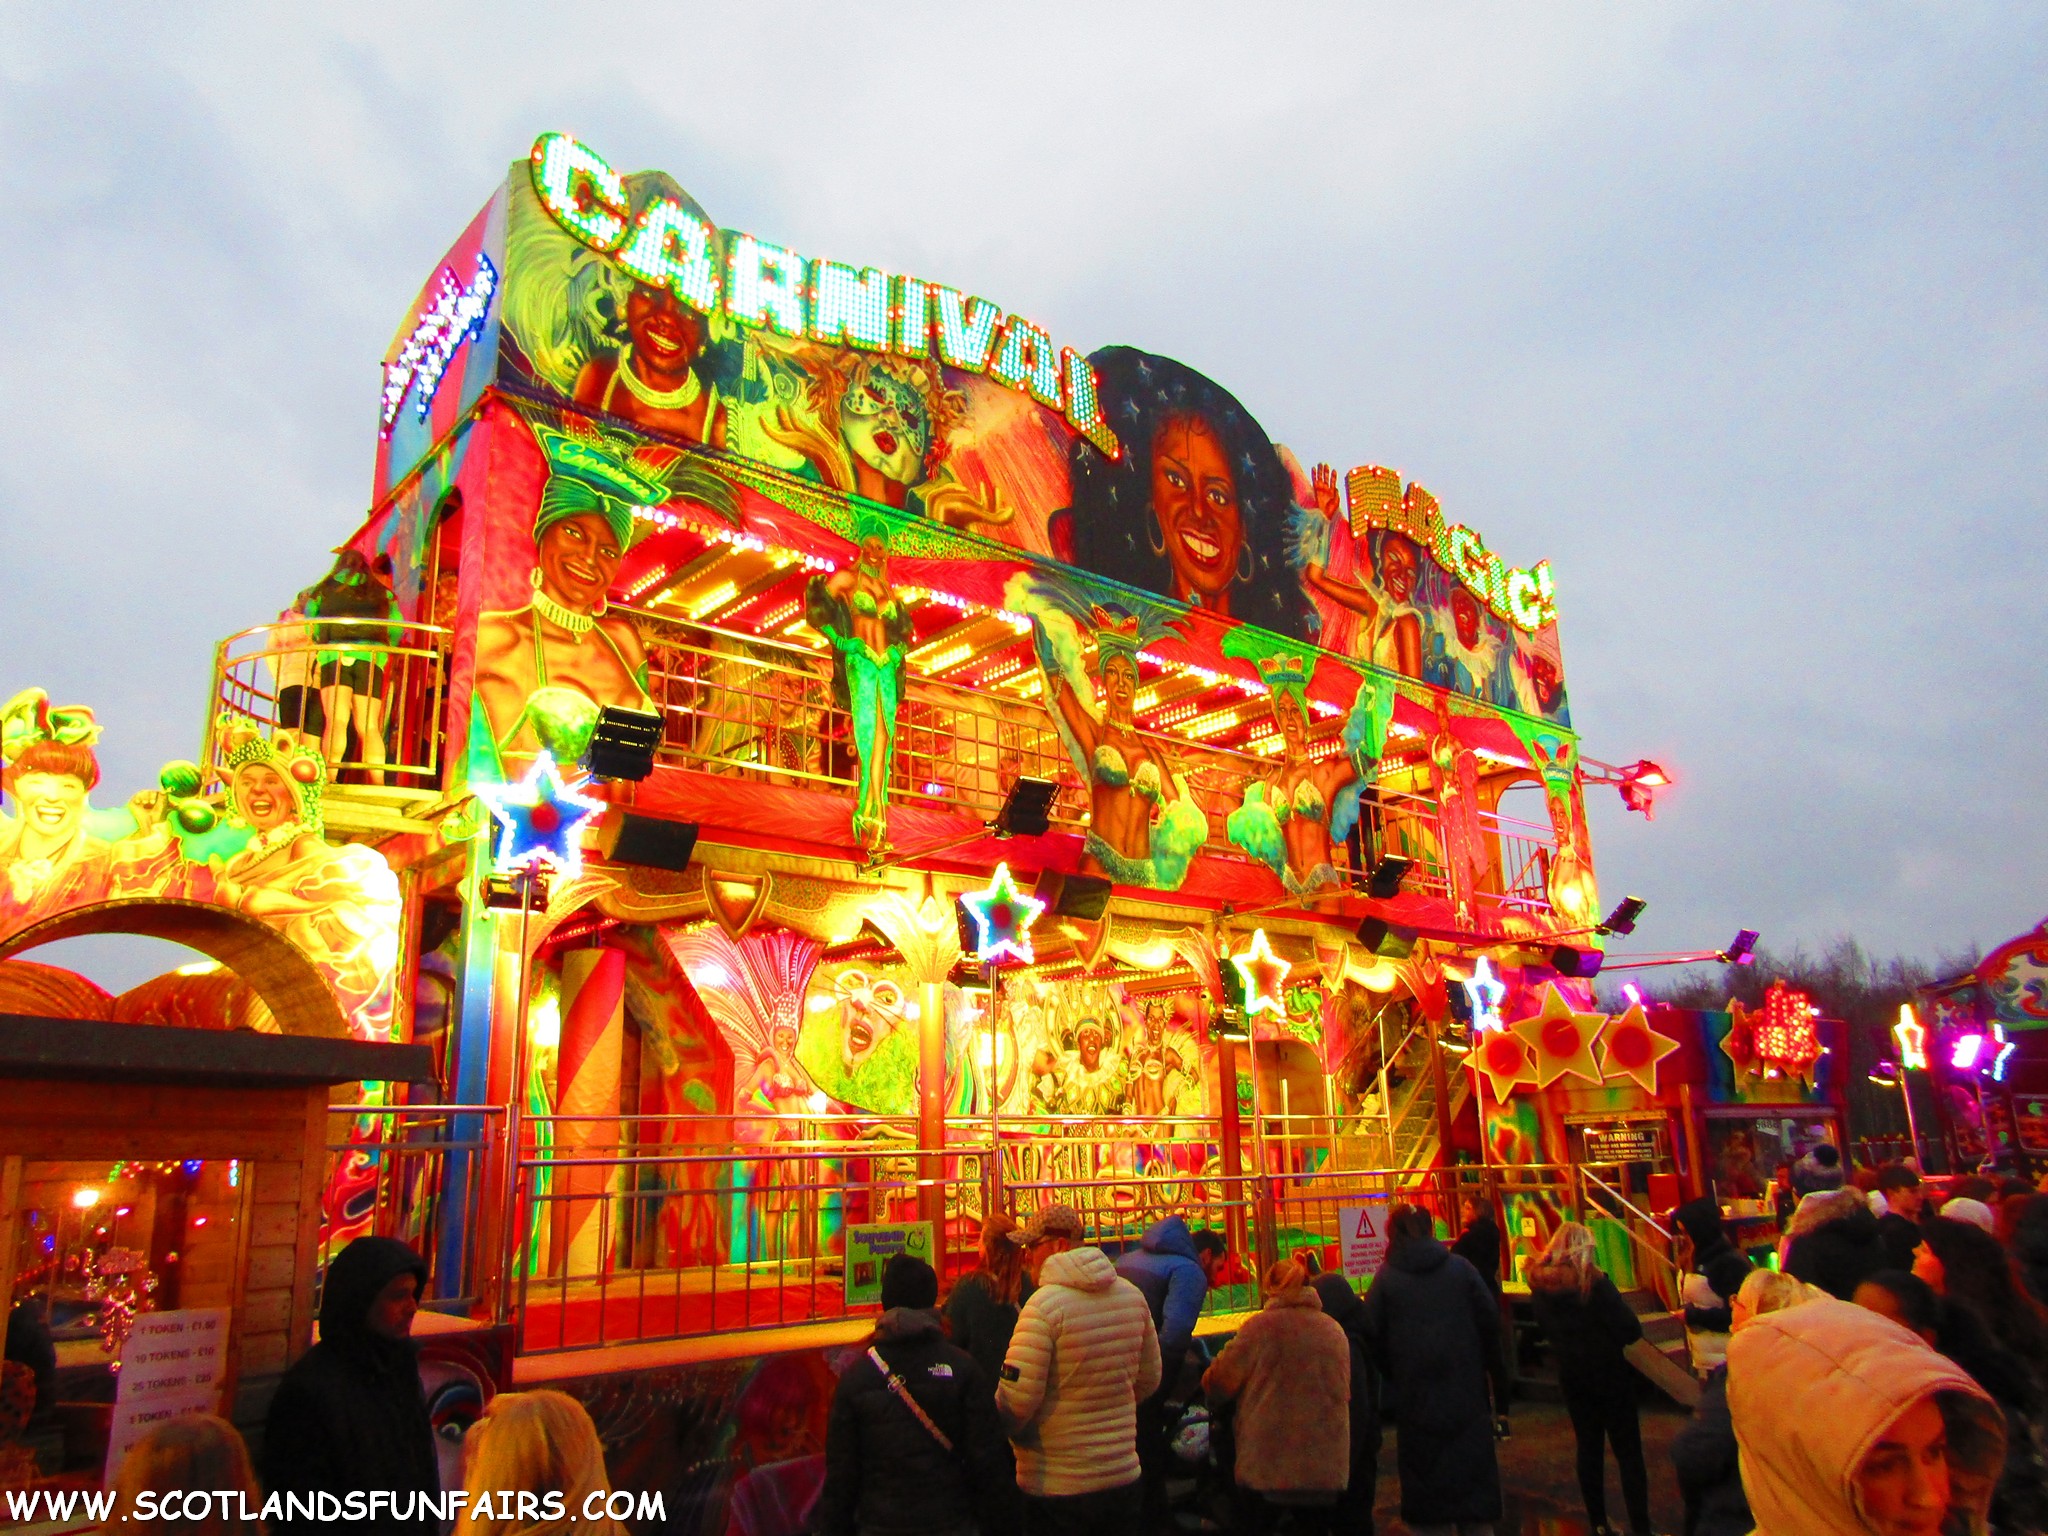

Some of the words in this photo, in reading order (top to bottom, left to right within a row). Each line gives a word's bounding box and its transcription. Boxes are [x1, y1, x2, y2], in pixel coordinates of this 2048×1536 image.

[531, 132, 1120, 461] CARNIVAL
[1598, 1131, 1645, 1143] WARNING
[149, 1323, 184, 1335] TOKEN
[138, 1409, 172, 1423] TOKEN
